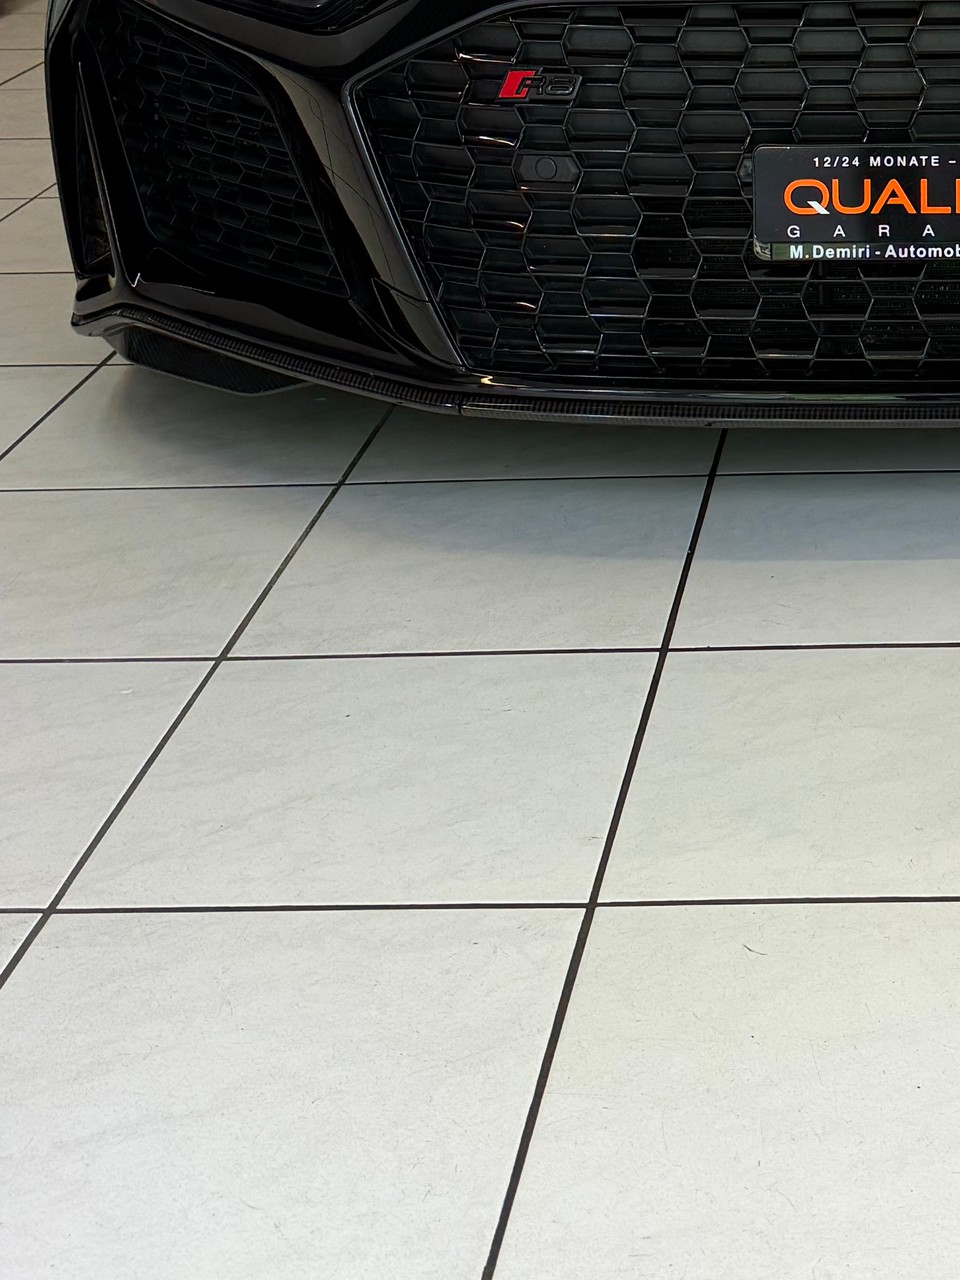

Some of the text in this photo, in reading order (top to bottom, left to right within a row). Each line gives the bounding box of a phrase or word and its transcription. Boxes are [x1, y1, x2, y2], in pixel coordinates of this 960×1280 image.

[514, 75, 576, 97] R8
[812, 155, 861, 168] 12/24
[869, 155, 941, 167] MONATE
